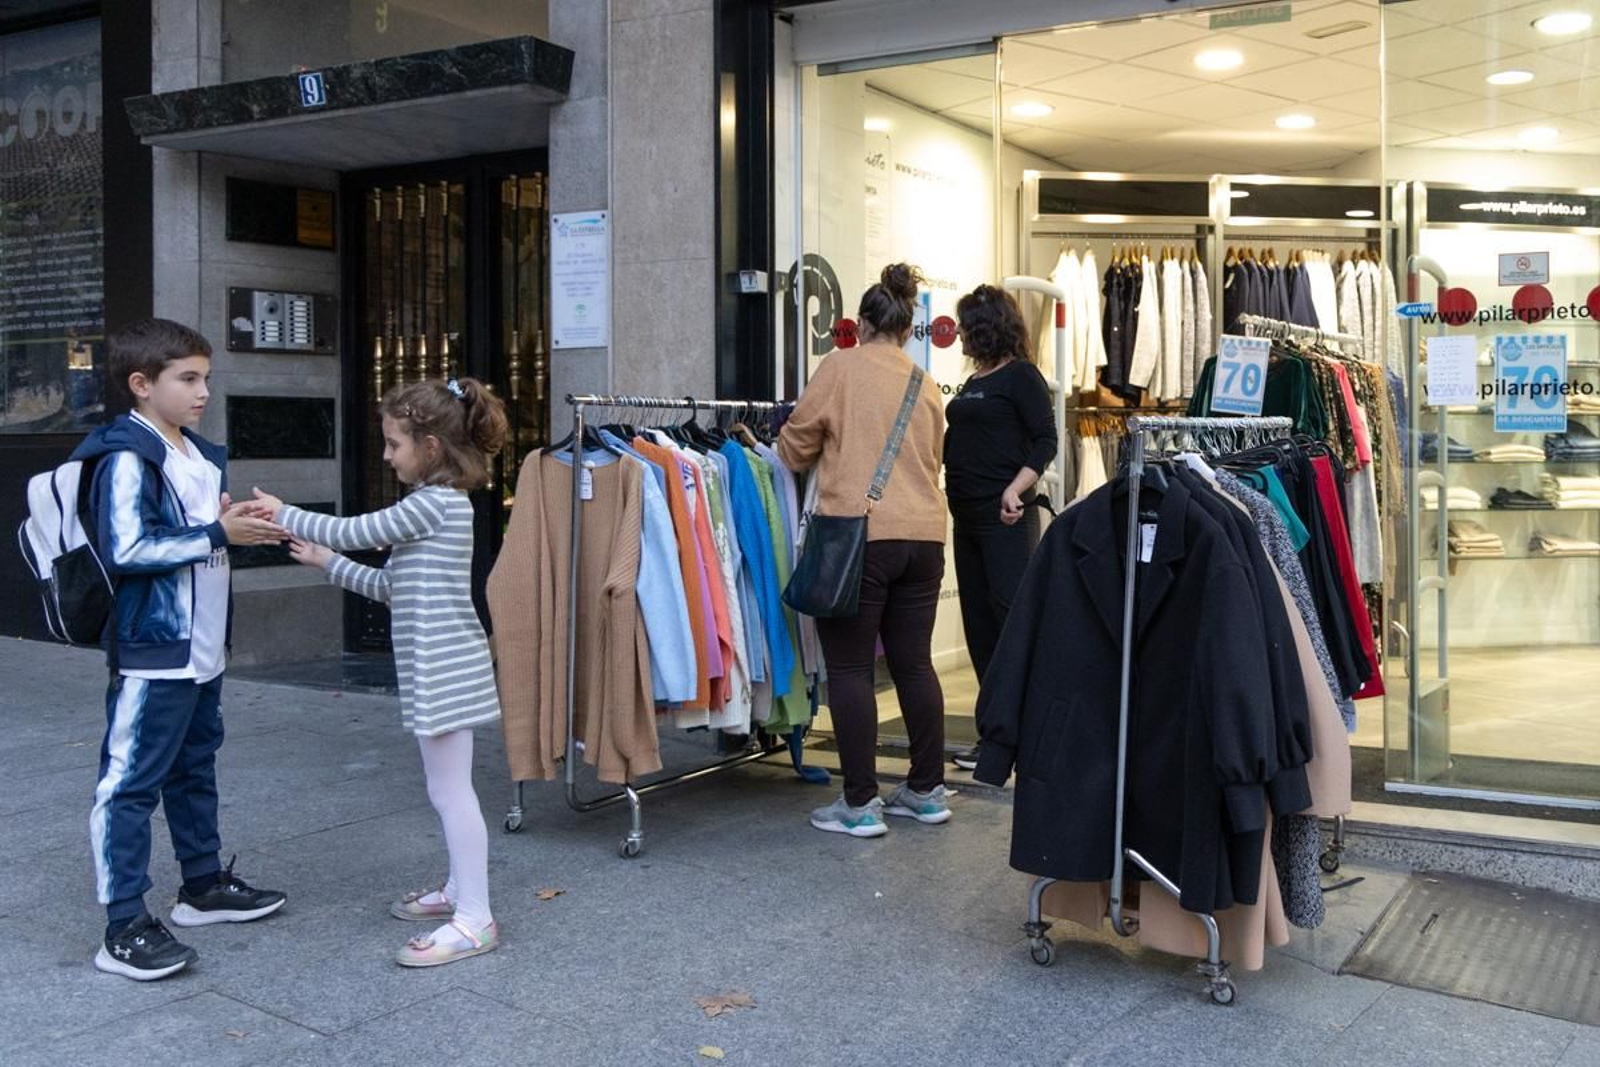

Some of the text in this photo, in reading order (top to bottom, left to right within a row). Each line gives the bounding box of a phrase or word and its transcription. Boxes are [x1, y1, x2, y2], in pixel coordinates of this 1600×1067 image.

[304, 76, 319, 104] 9
[1481, 201, 1586, 216] www.pilarprieto.es
[1405, 306, 1431, 315] AUTO
[1221, 361, 1262, 397] 70
[1502, 365, 1559, 410] 70
